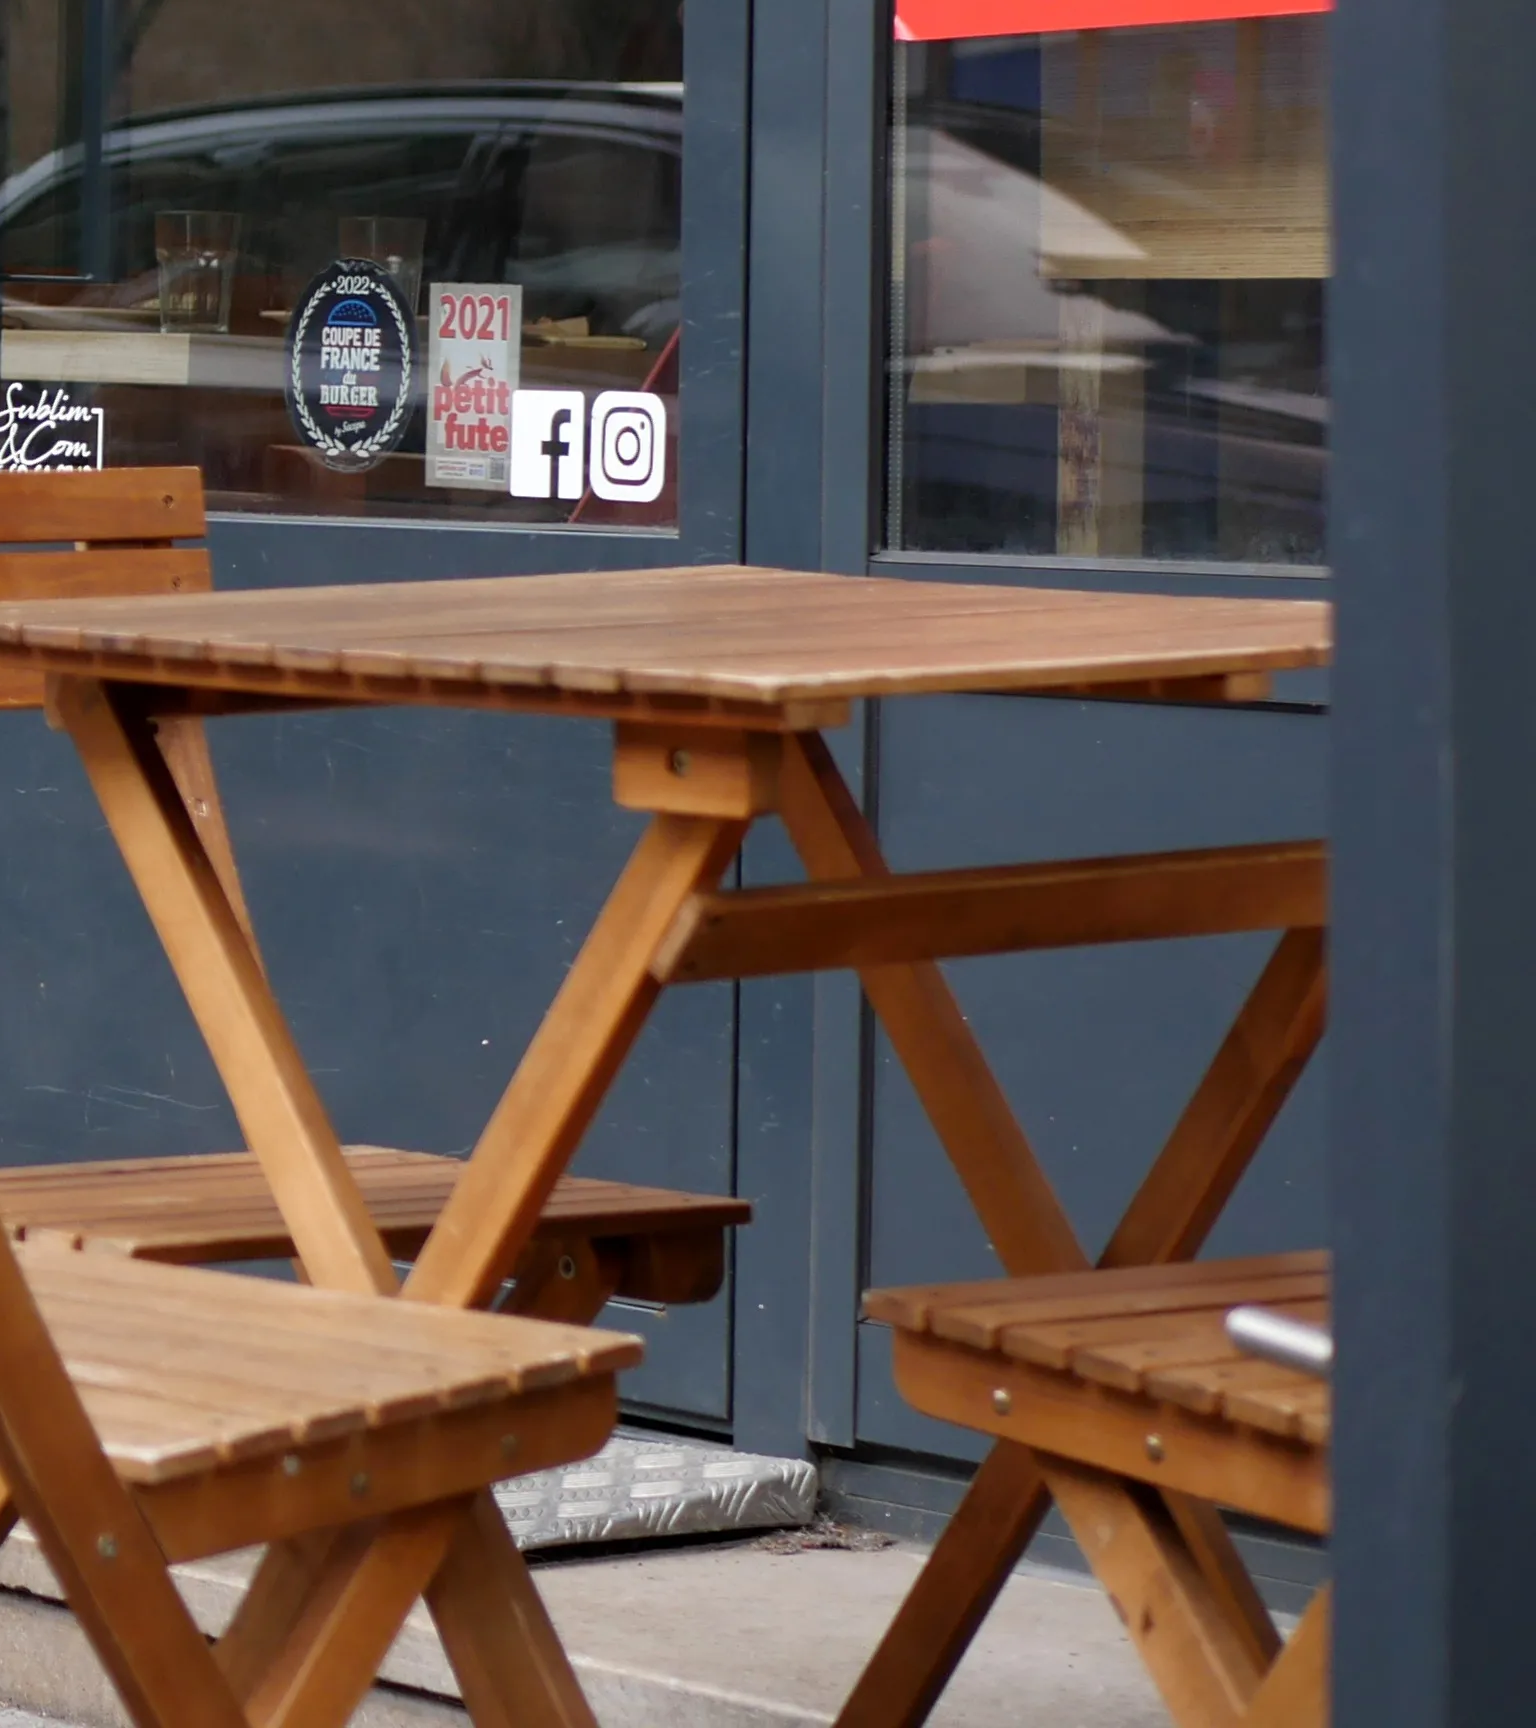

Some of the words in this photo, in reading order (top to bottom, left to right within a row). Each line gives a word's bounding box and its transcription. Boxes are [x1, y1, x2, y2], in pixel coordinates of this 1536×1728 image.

[439, 293, 510, 341] 2021
[321, 326, 362, 347] COUPE
[364, 328, 381, 347] DE
[320, 346, 381, 371] FRANCE
[342, 370, 357, 385] du
[319, 385, 379, 407] BURGER
[433, 378, 511, 422] petit
